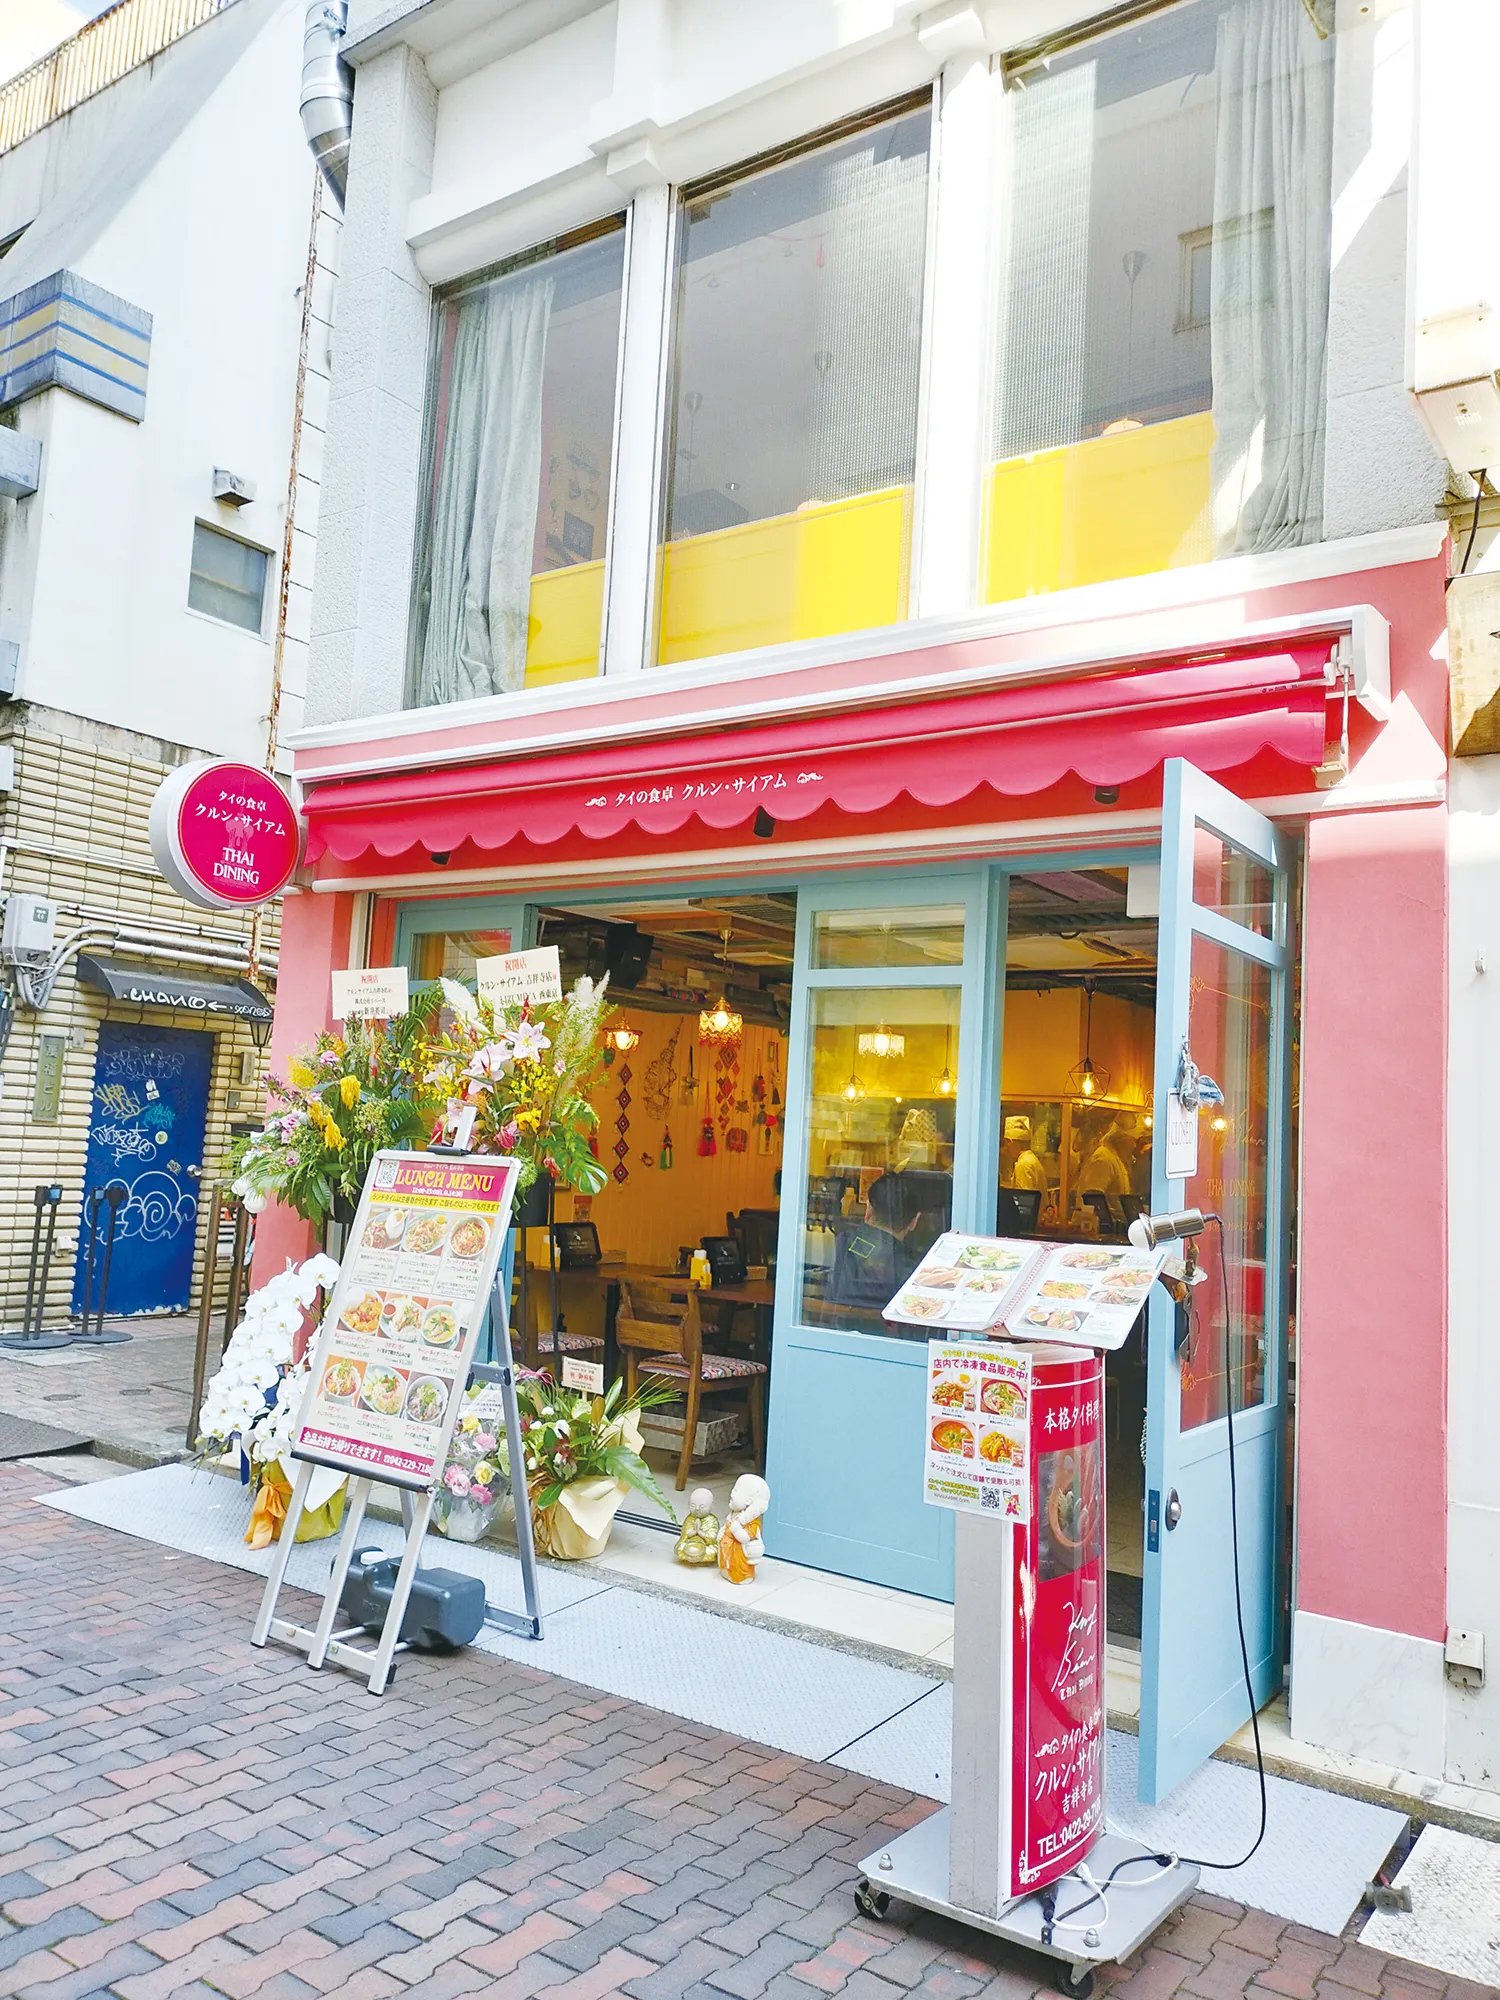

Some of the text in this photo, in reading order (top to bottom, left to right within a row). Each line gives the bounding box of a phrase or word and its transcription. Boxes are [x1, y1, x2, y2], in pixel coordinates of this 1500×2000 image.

[218, 790, 267, 813] タイの食卓
[615, 772, 788, 808] タイの食卓 クルン・サイアム
[195, 802, 286, 837] クルン・サイアム
[222, 846, 255, 867] THAI
[213, 862, 260, 885] DINING
[395, 1169, 495, 1192] LUNCH MENU
